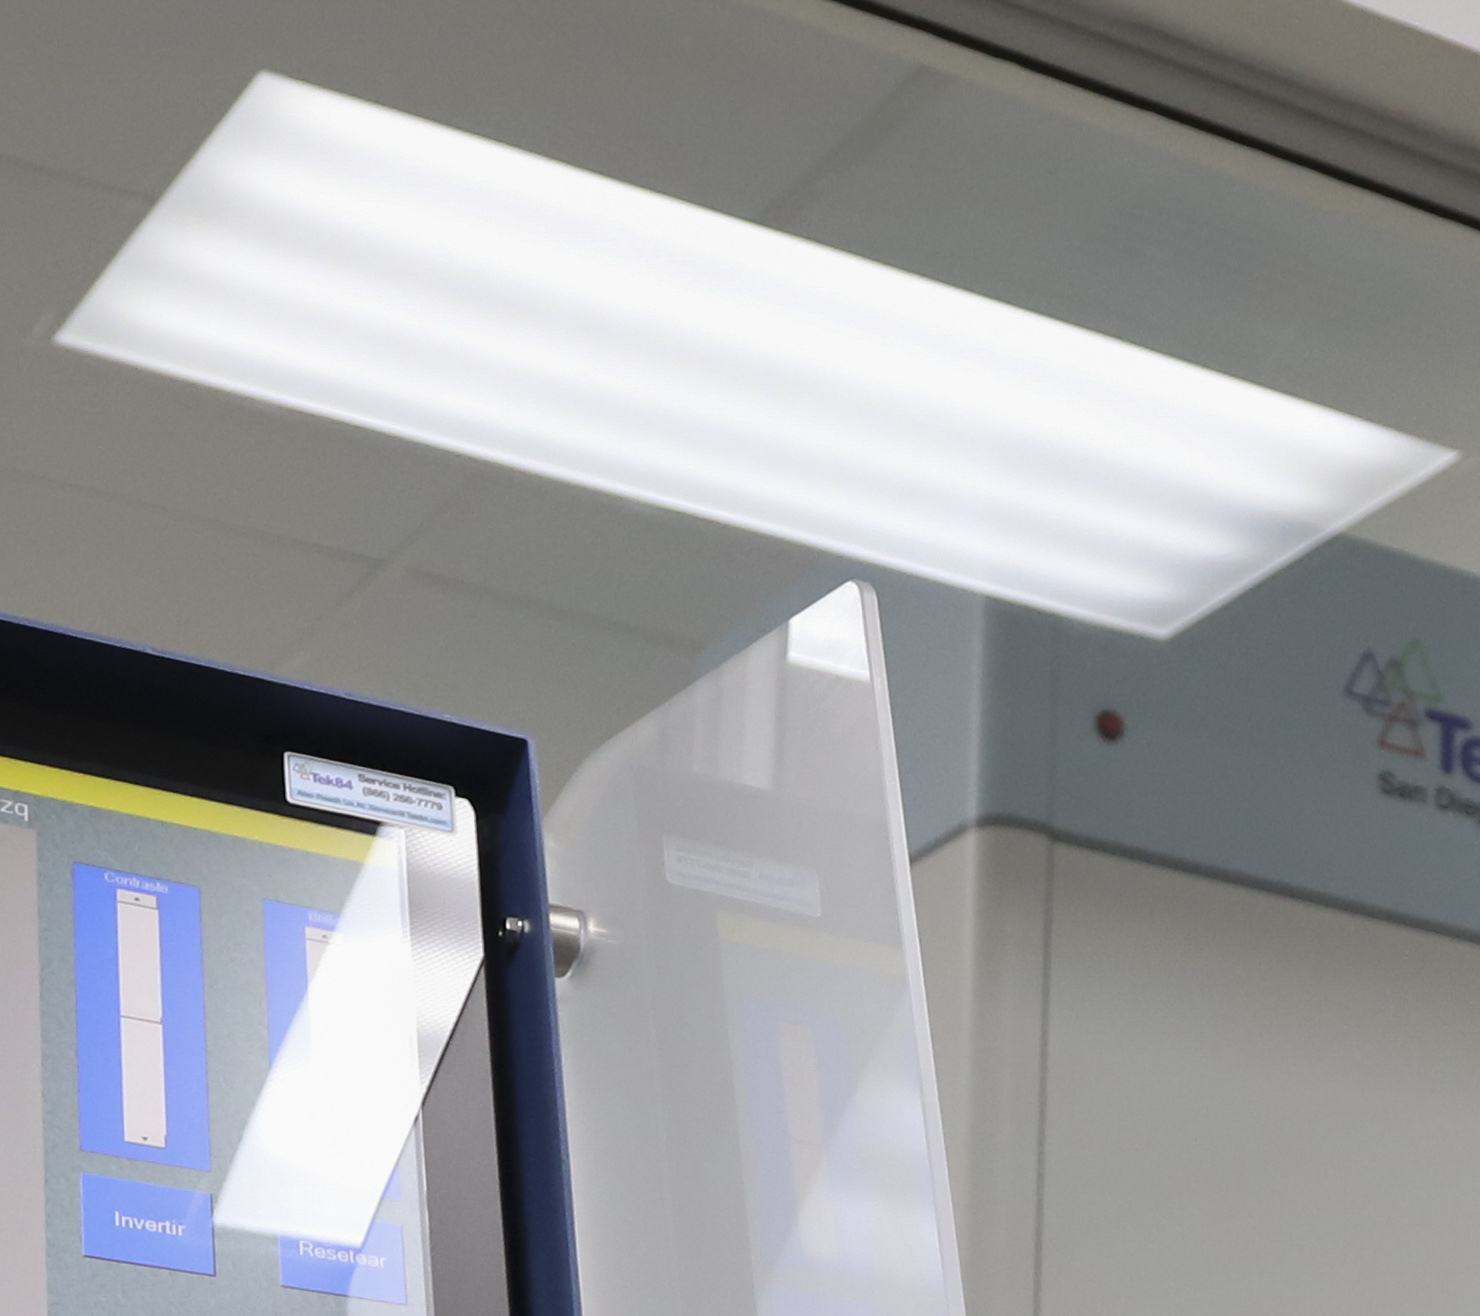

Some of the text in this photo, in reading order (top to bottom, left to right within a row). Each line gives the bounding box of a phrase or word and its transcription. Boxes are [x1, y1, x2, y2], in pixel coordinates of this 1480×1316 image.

[311, 772, 354, 790] Tek84
[114, 1210, 186, 1237] Invertir
[299, 1240, 387, 1268] Resetear
